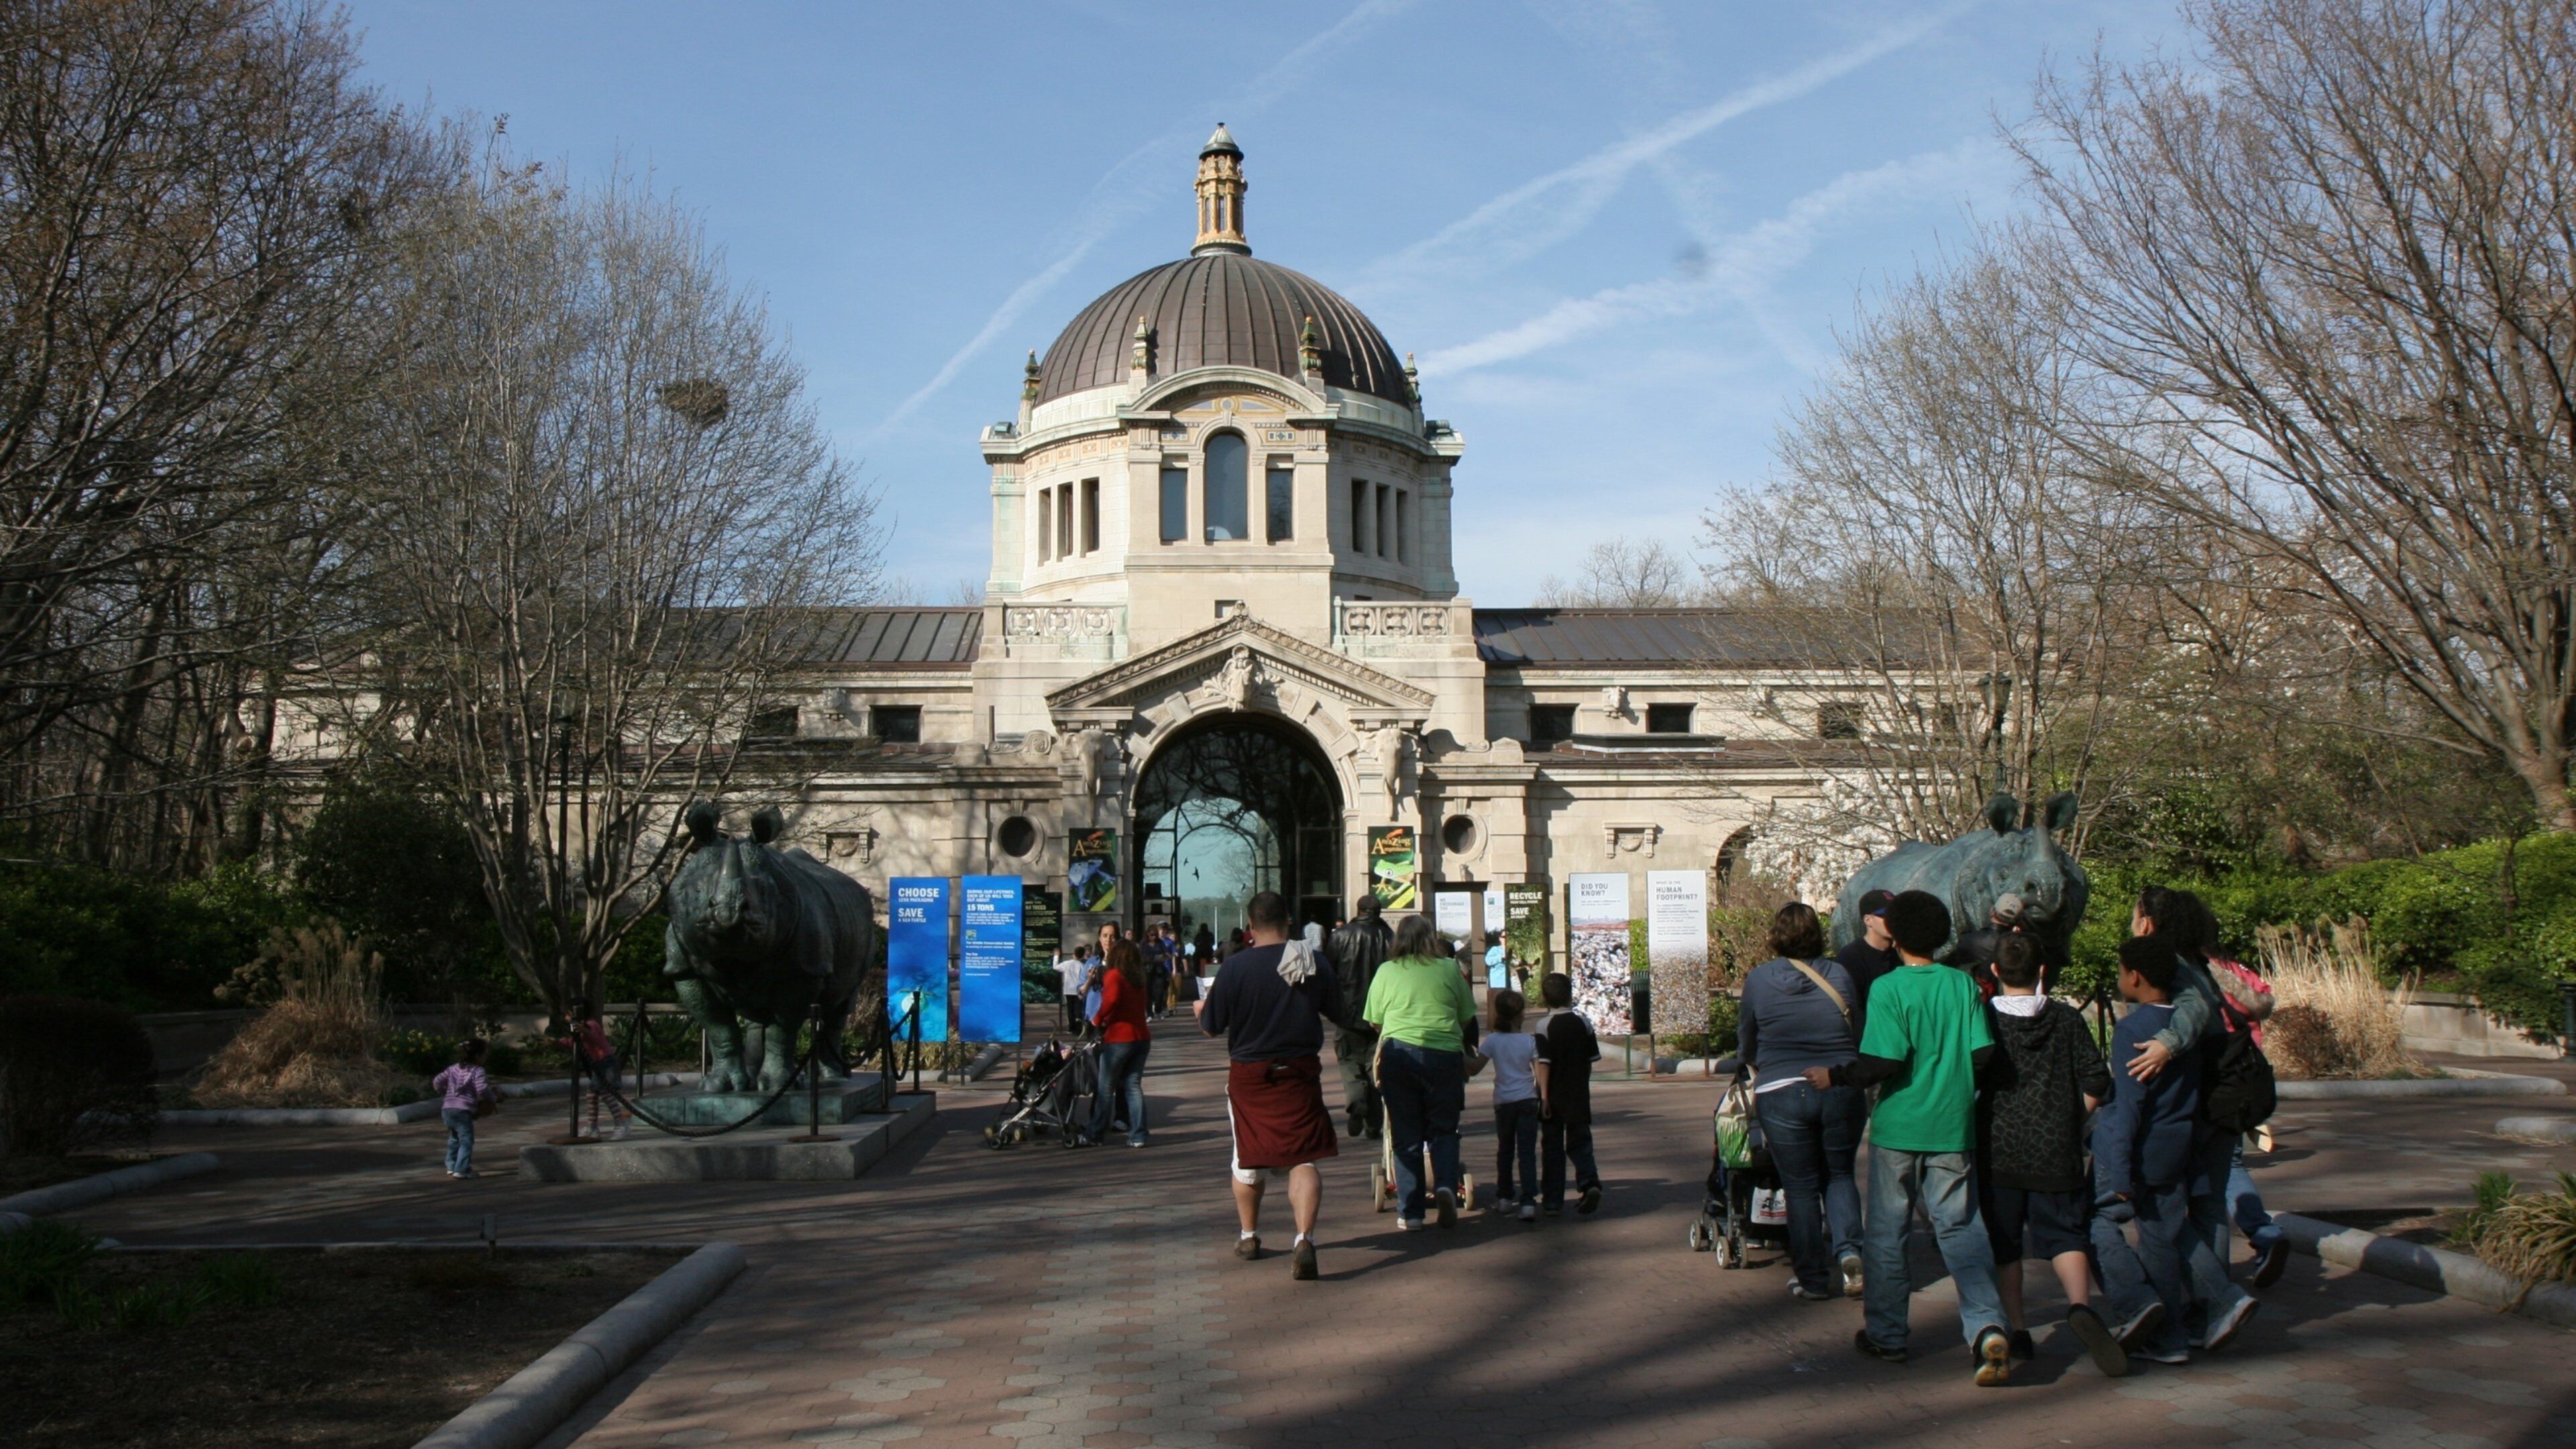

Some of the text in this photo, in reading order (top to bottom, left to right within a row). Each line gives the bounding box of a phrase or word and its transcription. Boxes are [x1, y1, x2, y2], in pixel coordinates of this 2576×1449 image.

[898, 888, 939, 898] CHOOSE
[1509, 892, 1542, 900] RECYCLE
[898, 908, 923, 918] SAVE
[1510, 907, 1529, 915] SAVE
